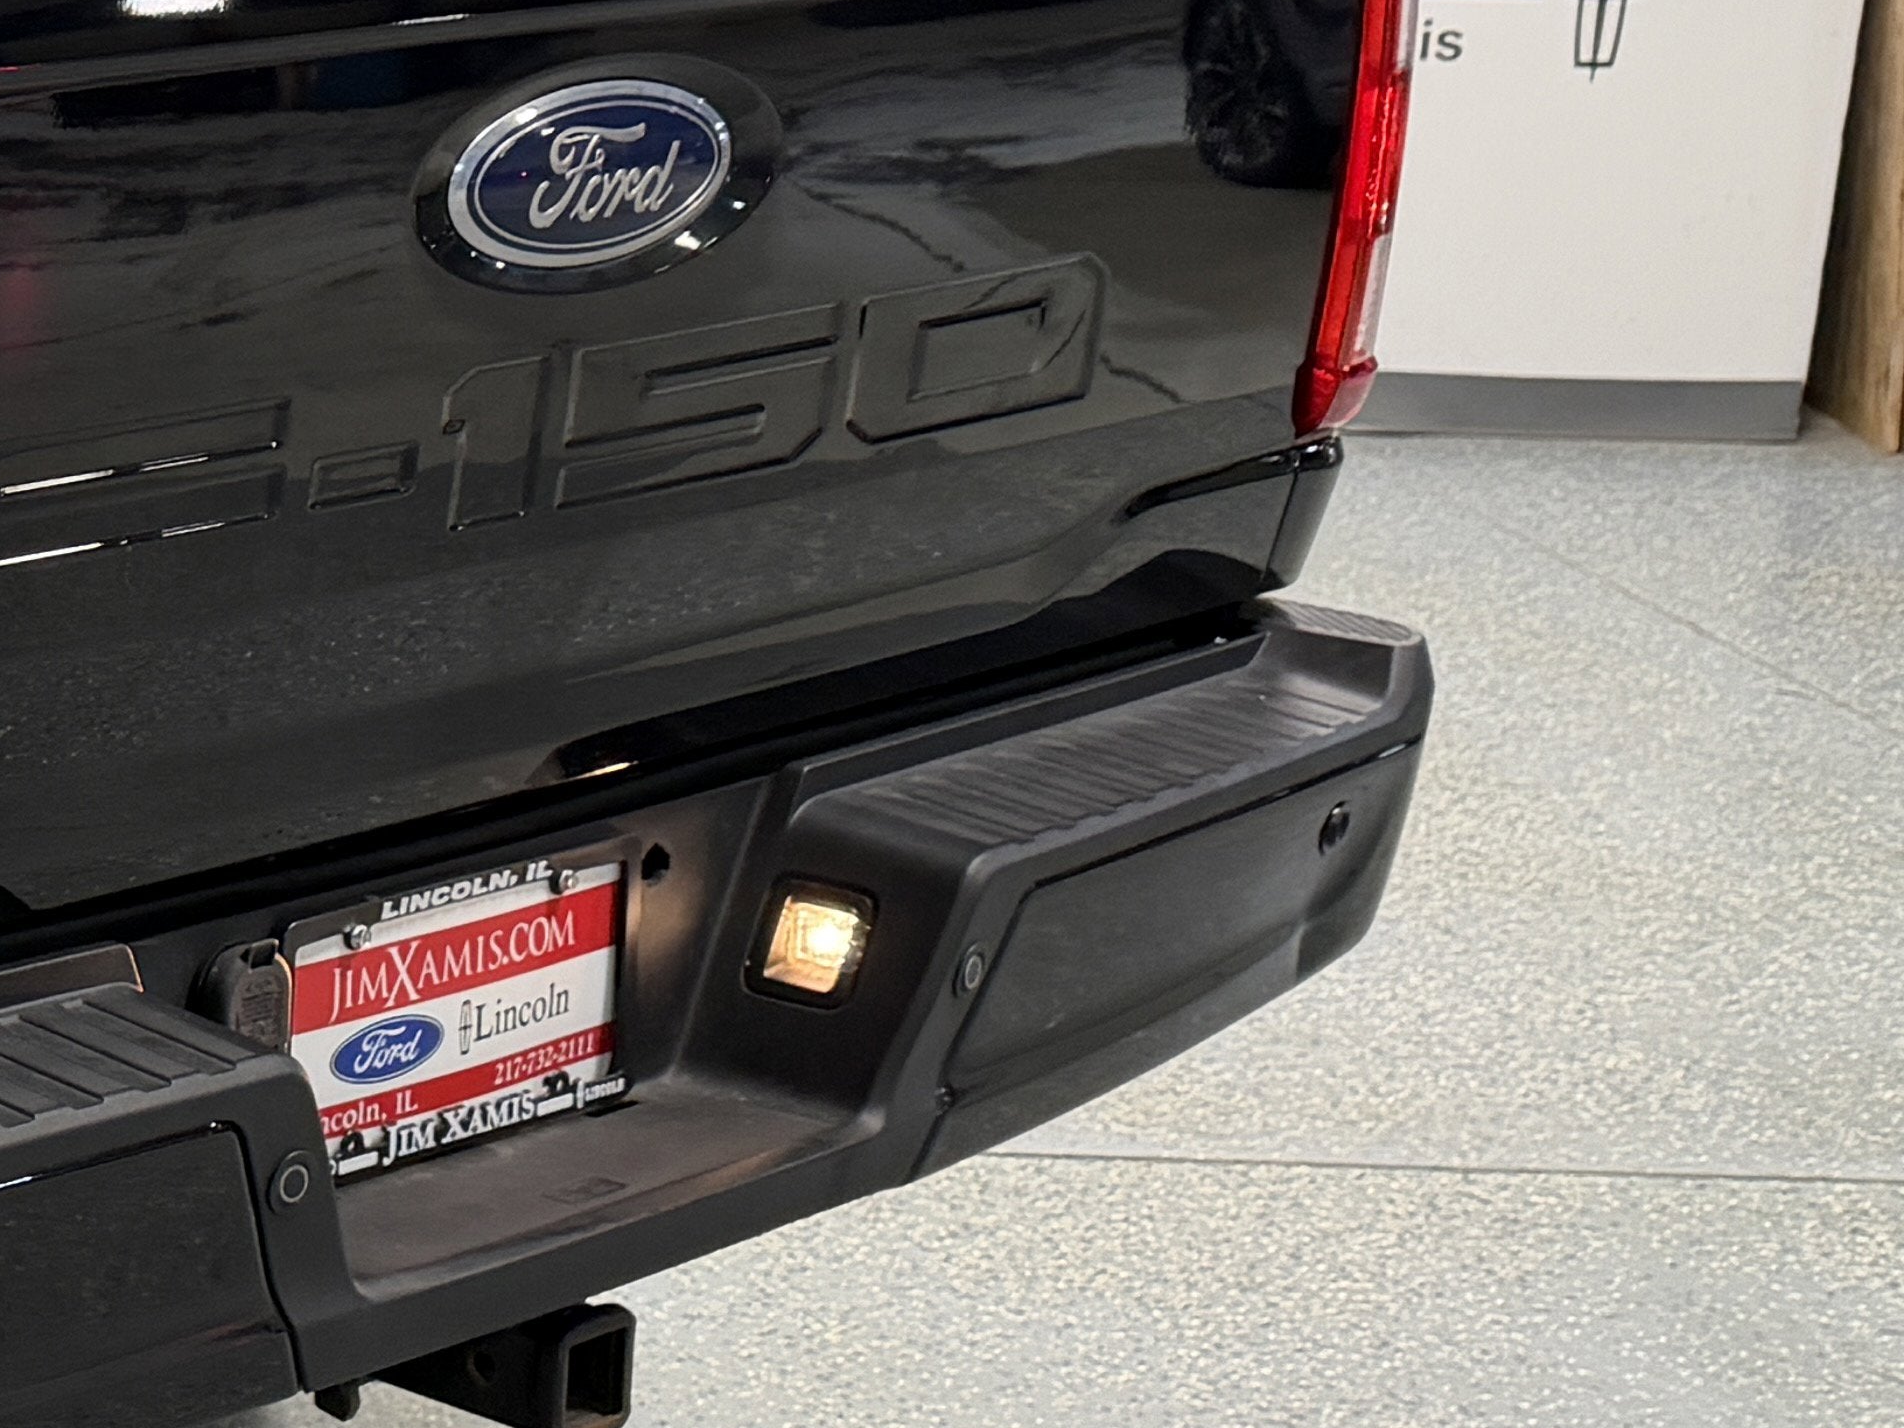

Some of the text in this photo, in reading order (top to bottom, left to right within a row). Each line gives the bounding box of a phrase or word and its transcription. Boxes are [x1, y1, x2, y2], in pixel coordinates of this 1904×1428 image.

[529, 122, 681, 229] Ford
[381, 869, 518, 920] LINCOLN,
[474, 982, 570, 1043] Lincoln
[354, 1025, 422, 1074] Ford
[382, 1091, 536, 1167] JIM XAMIS
[395, 1089, 419, 1115] IL
